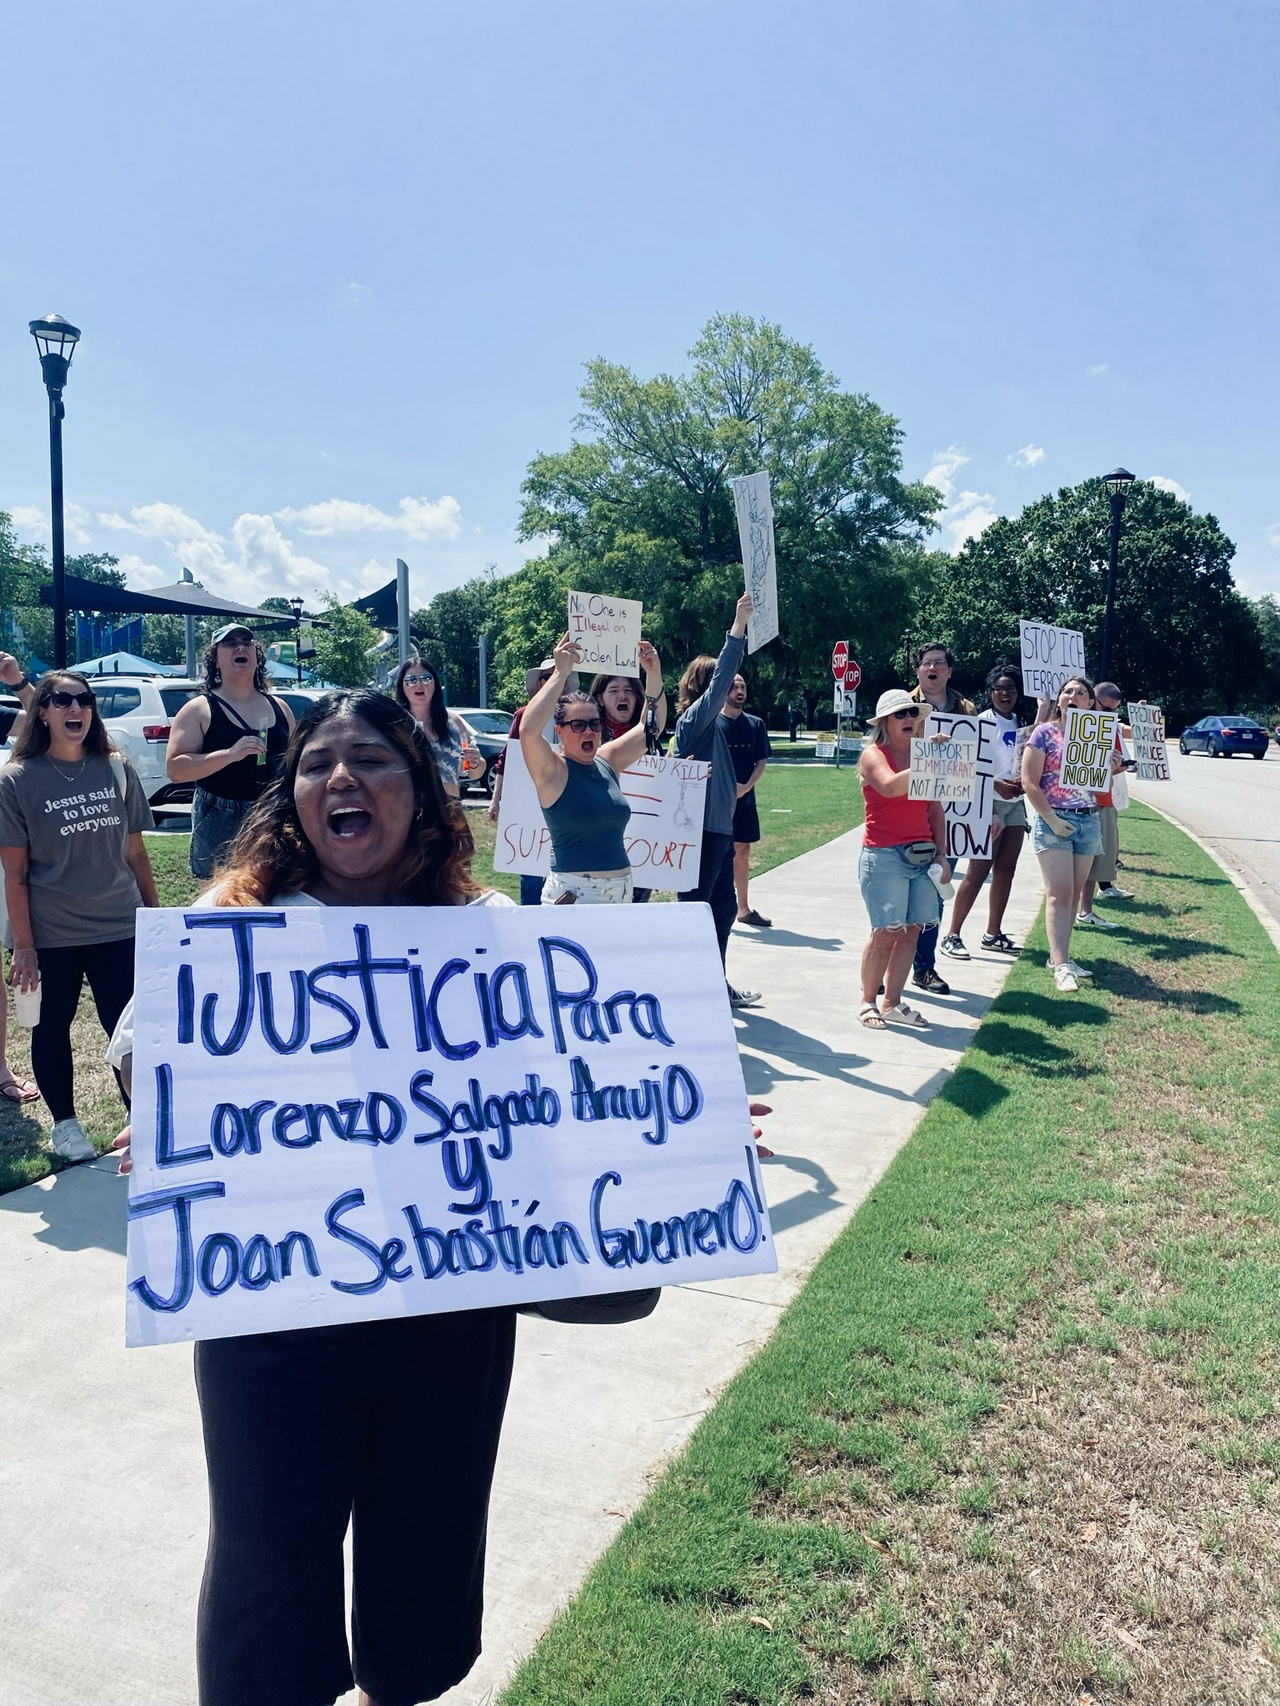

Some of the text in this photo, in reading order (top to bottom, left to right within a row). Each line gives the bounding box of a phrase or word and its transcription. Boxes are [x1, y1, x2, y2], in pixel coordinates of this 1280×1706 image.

[570, 594, 627, 618] No One is
[572, 615, 626, 637] Illegal on
[1023, 626, 1086, 669] STOP ICE
[833, 653, 847, 668] STOP
[845, 670, 859, 682] TOP
[1069, 711, 1115, 745] ICE
[915, 740, 974, 761] SUPPORT
[1066, 741, 1112, 767] OUT
[637, 755, 708, 781] AND KILL
[912, 757, 976, 780] IMMIGRANTS
[1063, 764, 1108, 788] NOW
[44, 786, 116, 813] Jesus said
[909, 778, 931, 797] NOT
[933, 777, 971, 800] FACISM
[62, 803, 109, 820] to love
[60, 815, 121, 836] everyone
[538, 936, 675, 1054] Para
[155, 1055, 704, 1170] Lorenzo Salgado Araujo
[442, 1136, 492, 1215] y
[127, 1181, 322, 1313] Joan
[324, 1188, 590, 1296] Sebastián
